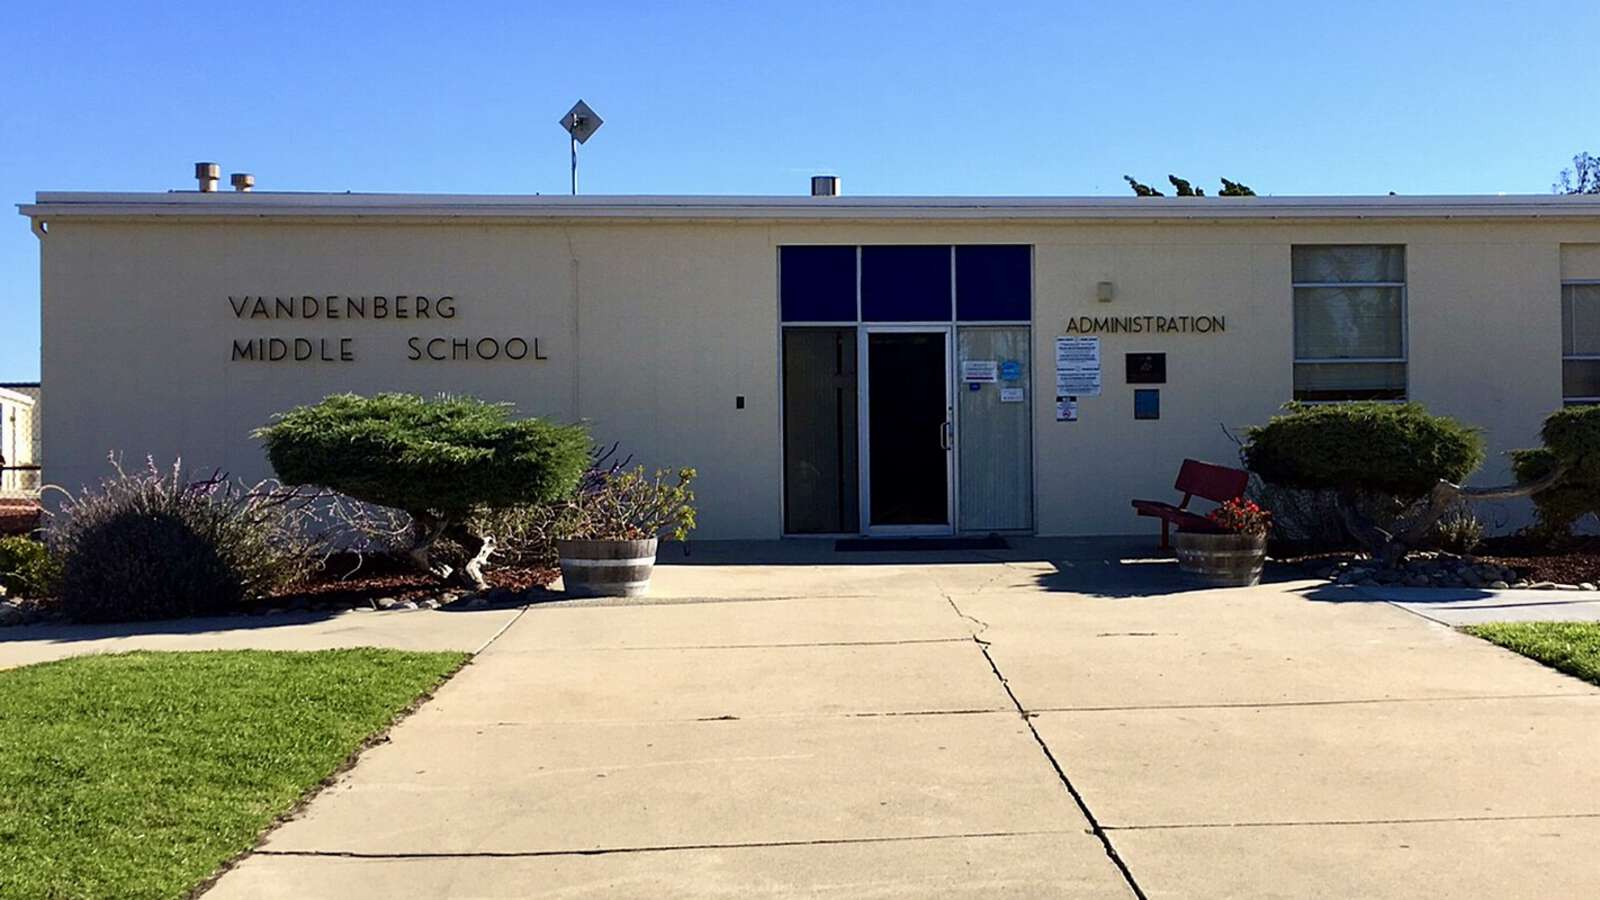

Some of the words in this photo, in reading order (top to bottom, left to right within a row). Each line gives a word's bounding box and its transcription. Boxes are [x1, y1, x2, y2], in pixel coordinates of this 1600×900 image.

[228, 296, 456, 319] VANDENBERG
[1066, 316, 1225, 333] ADMINISTRATION
[232, 338, 355, 361] MIDDLE
[407, 337, 548, 361] SCHOOL
